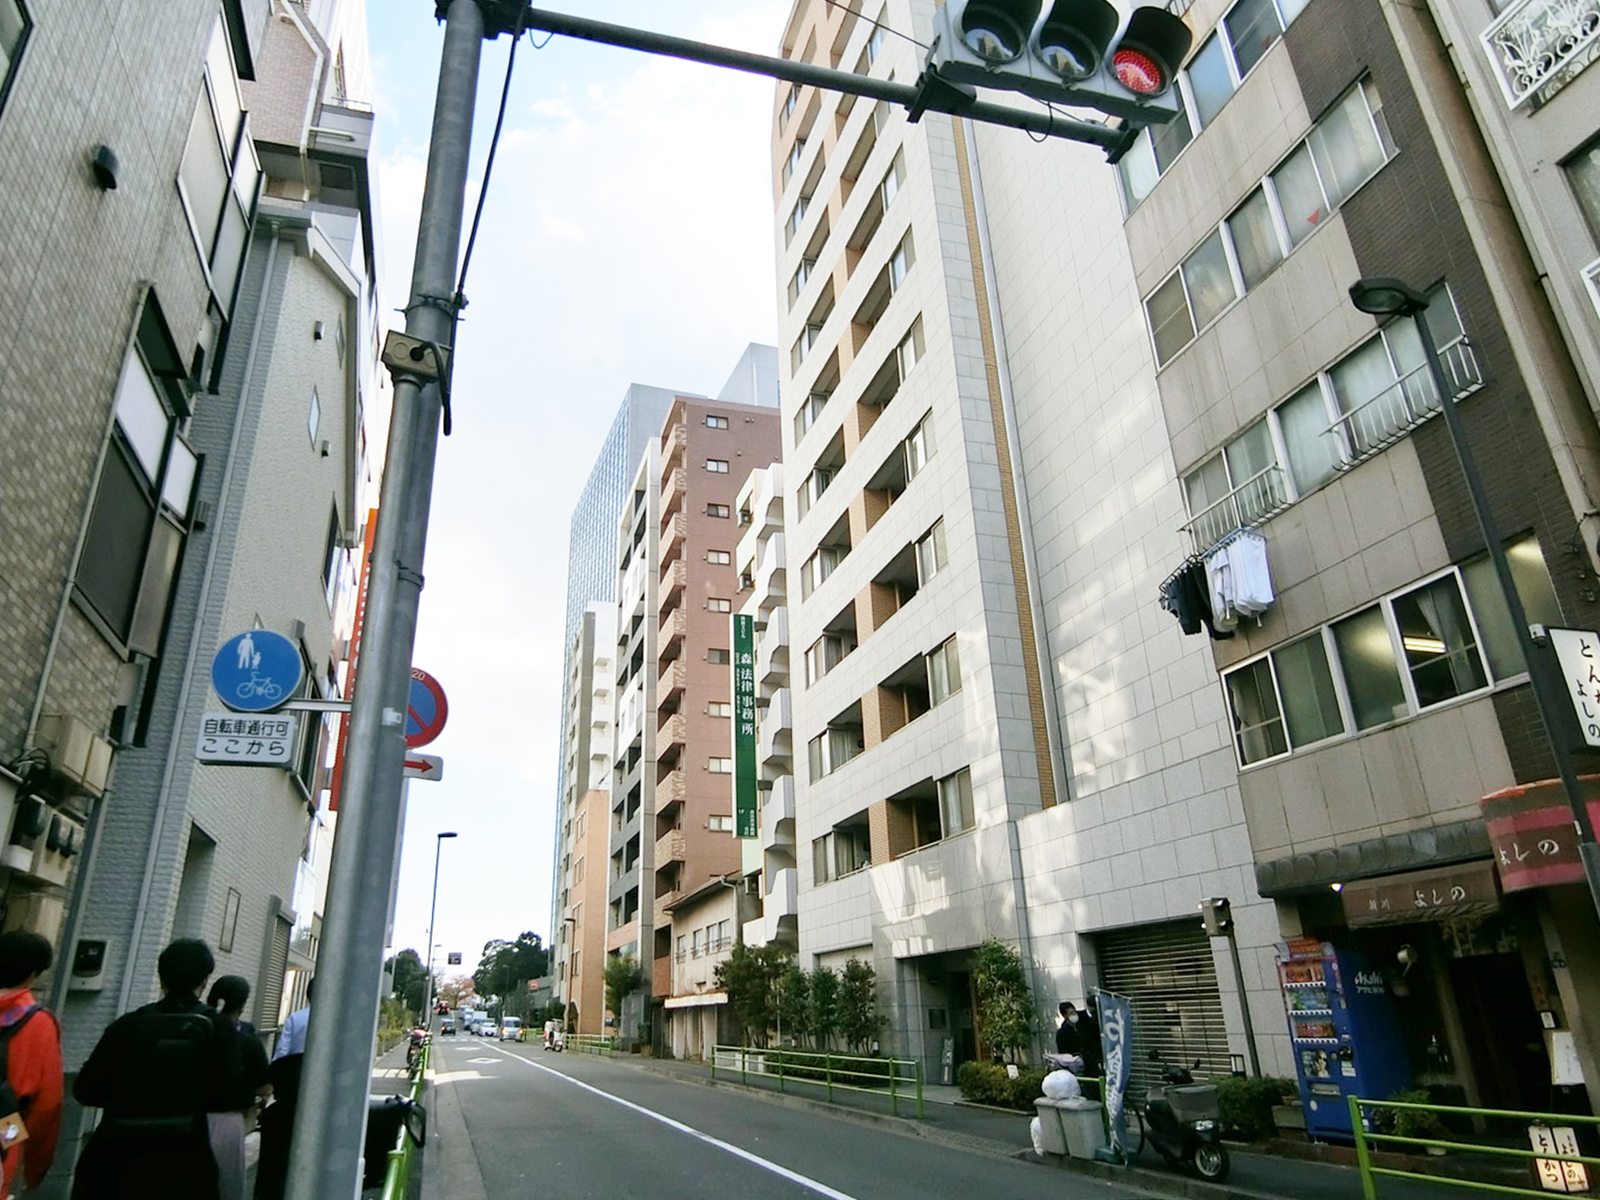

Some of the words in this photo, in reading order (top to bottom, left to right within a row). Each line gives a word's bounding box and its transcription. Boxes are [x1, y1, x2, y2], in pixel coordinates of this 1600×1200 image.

[741, 653, 754, 735] 森法律事務所
[1577, 679, 1600, 739] よしの
[204, 719, 290, 737] 自転車通行可
[202, 738, 285, 756] ここから
[1500, 838, 1560, 866] よしの
[1413, 886, 1466, 908] よしの
[1354, 970, 1383, 986] Asahi
[1538, 1133, 1559, 1183] とかつ
